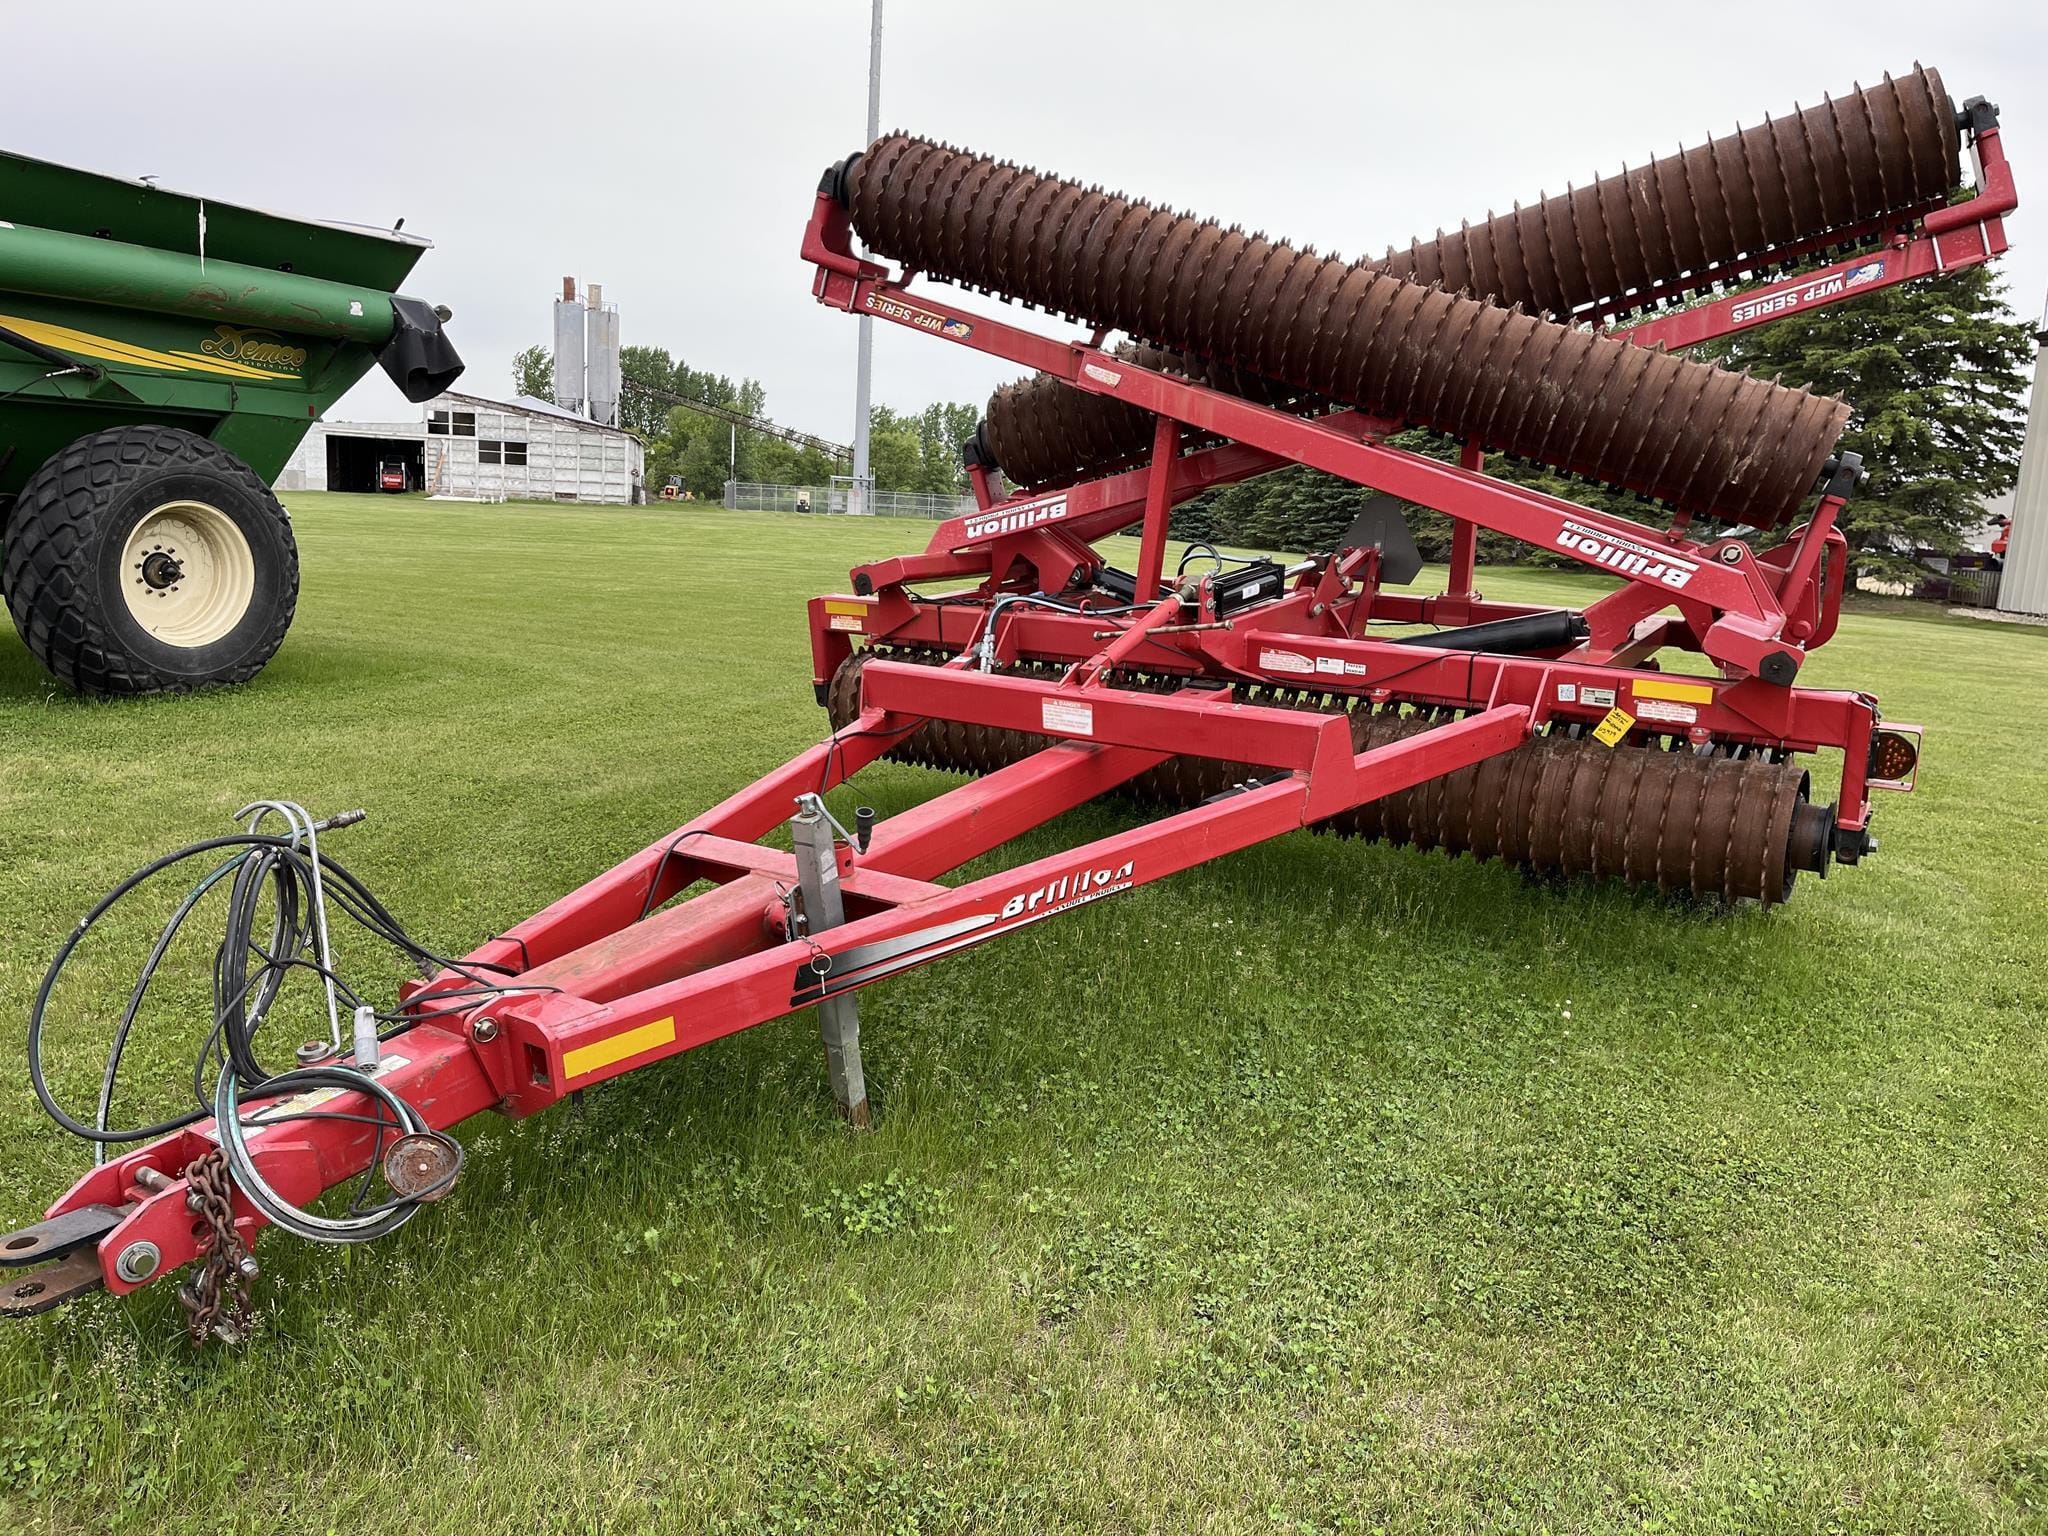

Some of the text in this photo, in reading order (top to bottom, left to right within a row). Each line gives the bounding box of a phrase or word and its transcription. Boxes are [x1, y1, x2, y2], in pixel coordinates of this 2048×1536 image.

[865, 296, 942, 331] WFP SERIES
[1732, 279, 1843, 322] WFP SERIES
[201, 325, 307, 367] Demco
[966, 502, 1067, 540] Brillion
[1556, 529, 1693, 589] Brillion
[1001, 860, 1135, 920] Brillion
